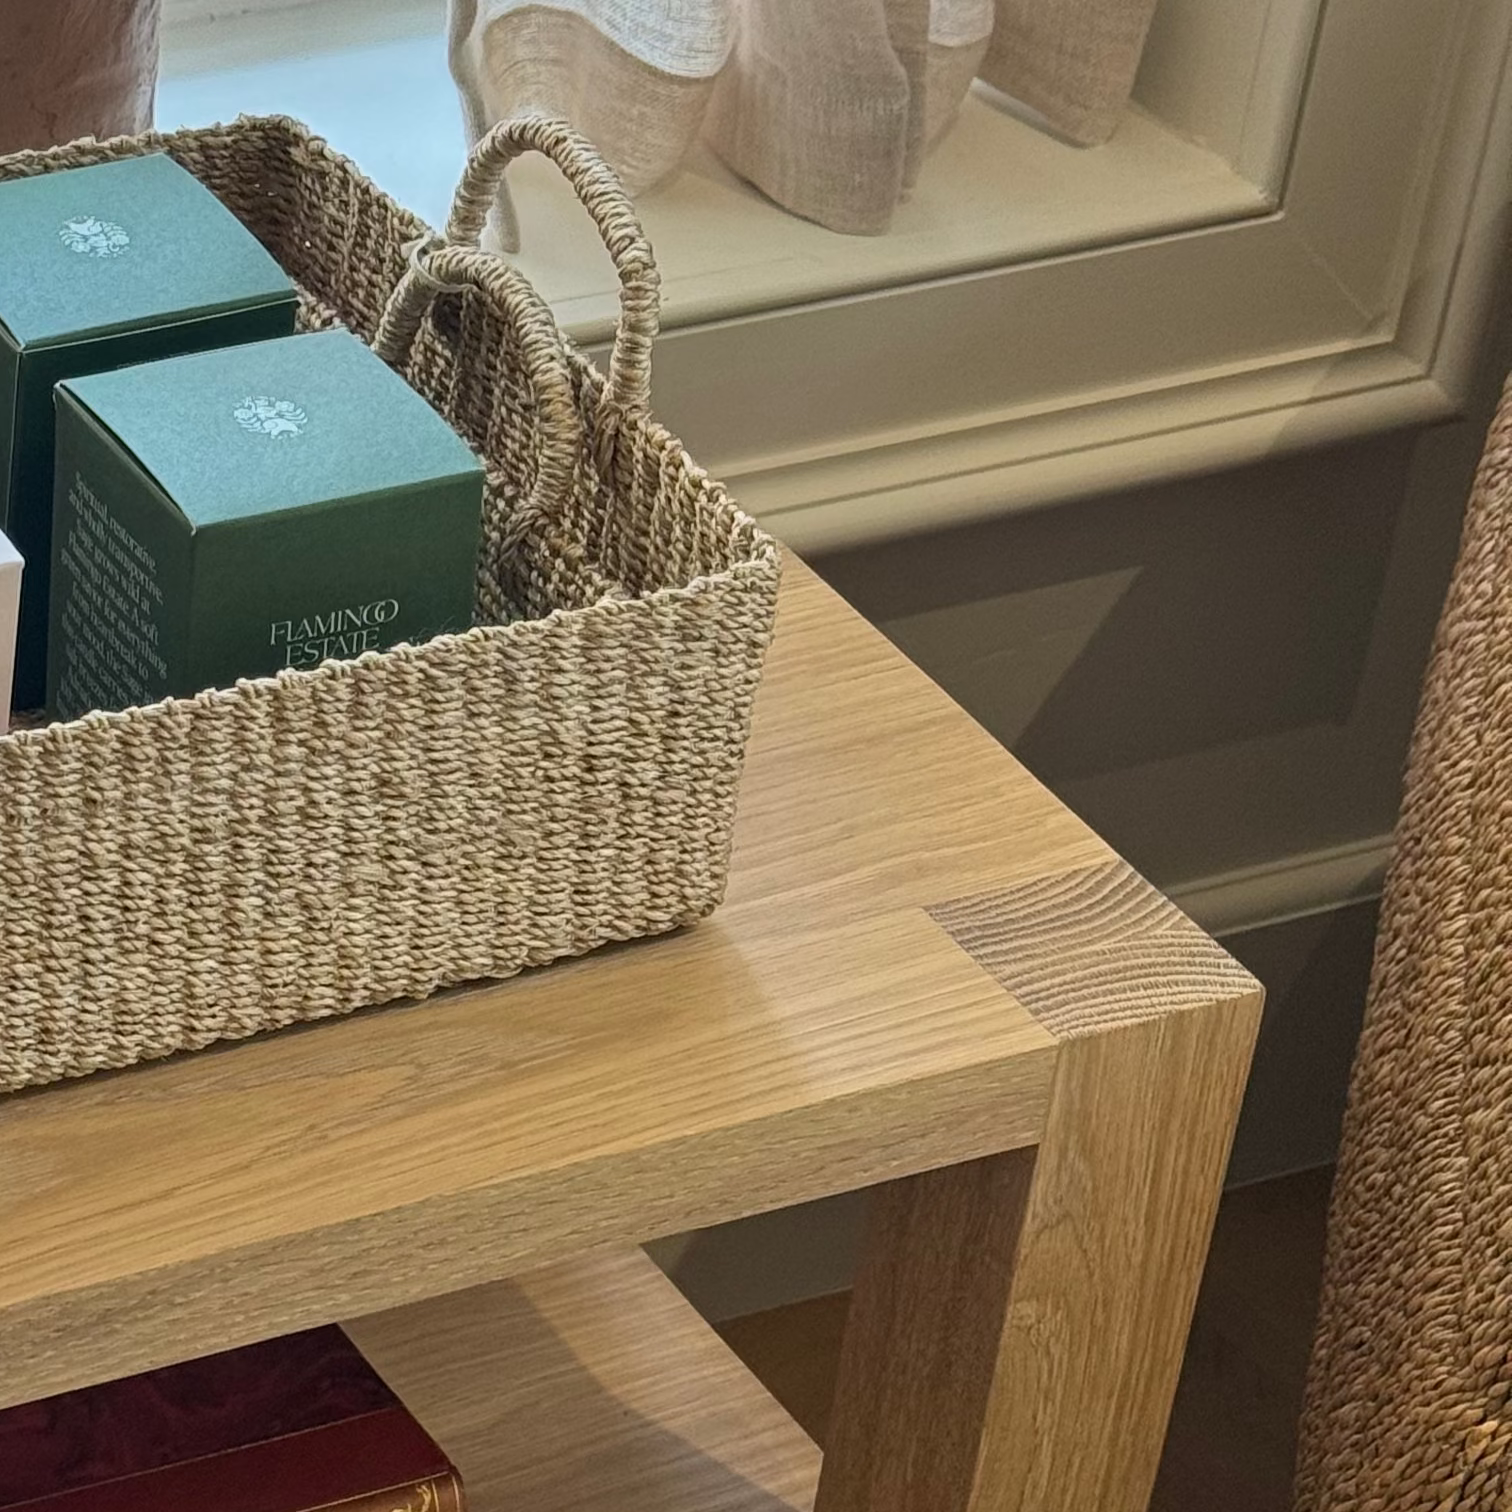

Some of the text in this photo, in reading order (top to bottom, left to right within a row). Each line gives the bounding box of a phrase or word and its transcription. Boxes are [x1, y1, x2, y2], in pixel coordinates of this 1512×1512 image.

[121, 574, 140, 602] wild
[141, 597, 150, 615] at
[131, 606, 139, 627] A
[270, 599, 399, 645] FLAMINGO
[118, 617, 168, 681] everything
[286, 627, 380, 666] ESTATE
[139, 661, 149, 681] to
